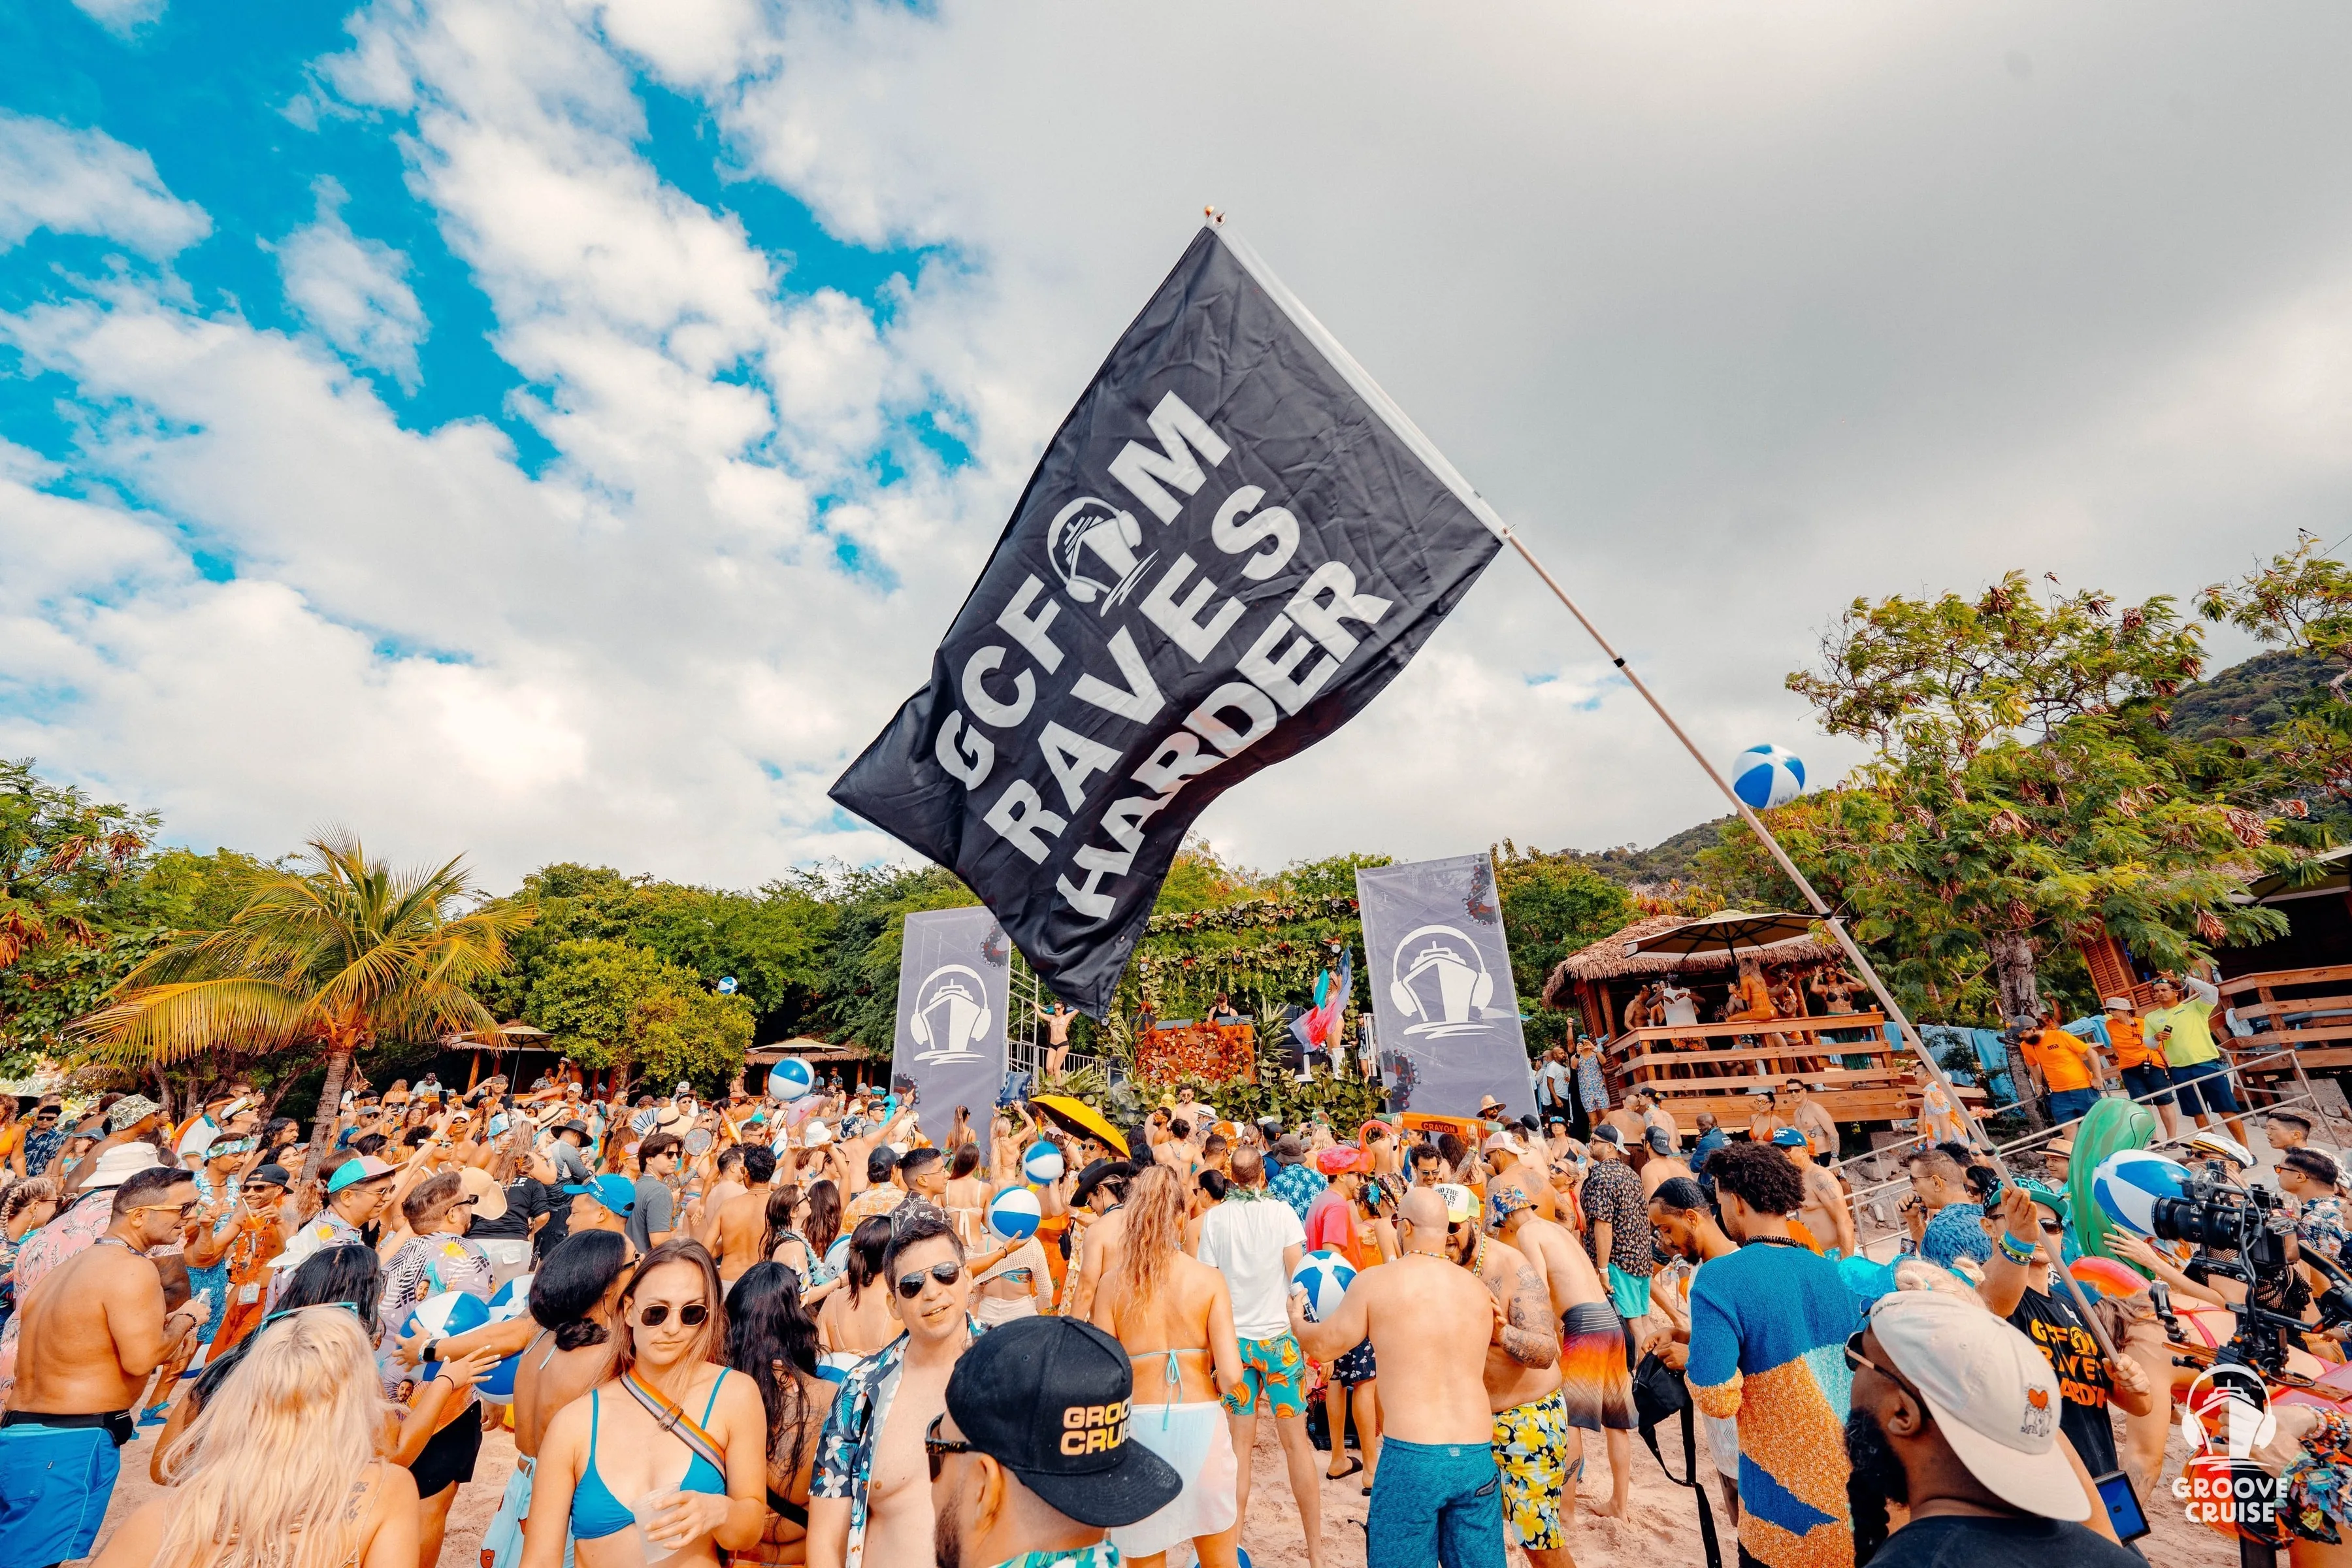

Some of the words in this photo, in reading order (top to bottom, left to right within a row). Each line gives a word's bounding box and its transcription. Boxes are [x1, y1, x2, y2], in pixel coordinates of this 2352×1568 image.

[982, 483, 1301, 864] RAVES
[1055, 560, 1394, 920] HARDER
[1423, 1123, 1456, 1134] CRAYON
[1446, 1188, 1459, 1197] THE
